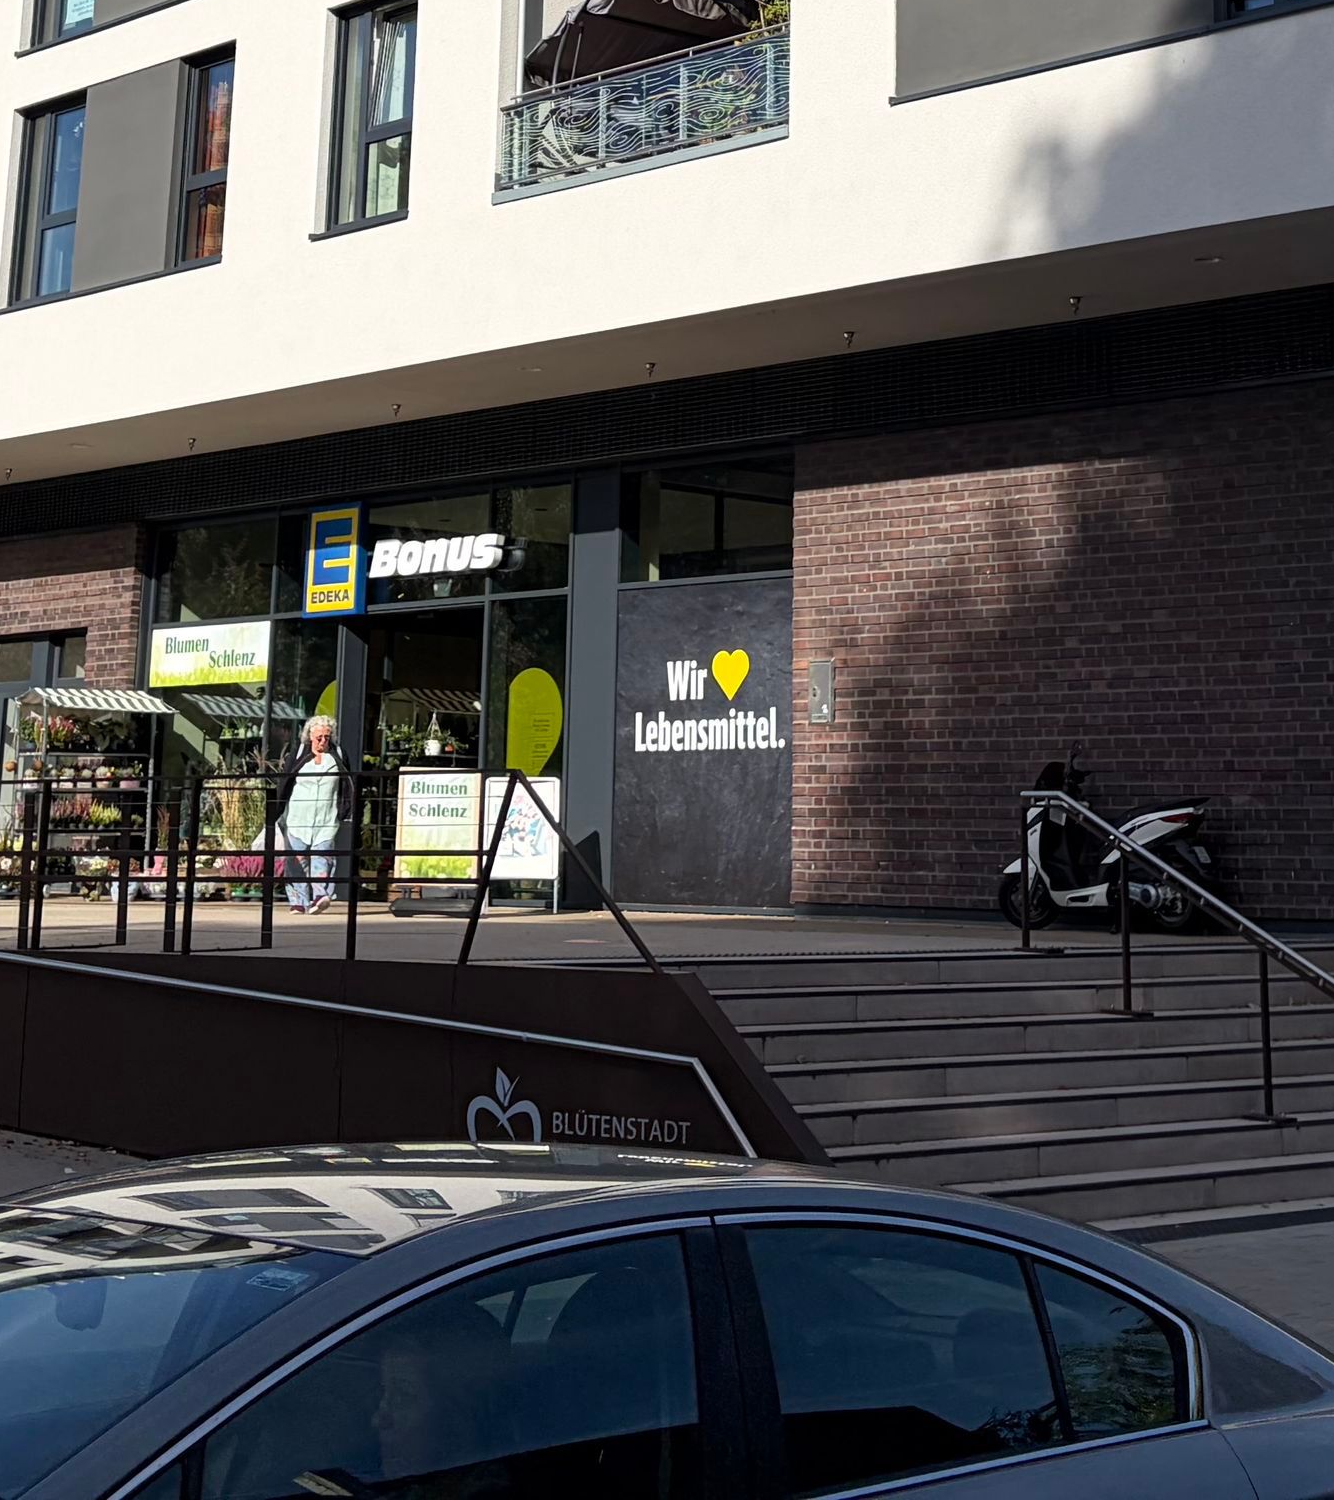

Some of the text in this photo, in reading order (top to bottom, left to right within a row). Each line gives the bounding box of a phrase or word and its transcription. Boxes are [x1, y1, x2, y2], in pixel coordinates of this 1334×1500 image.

[311, 589, 349, 604] EDEKA
[165, 637, 209, 654] Blumen
[208, 649, 256, 668] Schlenz
[667, 660, 707, 701] Wir
[634, 707, 786, 752] Lebensmittel.
[410, 781, 468, 795] Blumen
[408, 803, 468, 818] Schlenz
[552, 1109, 691, 1144] BLÜTENSTADT
